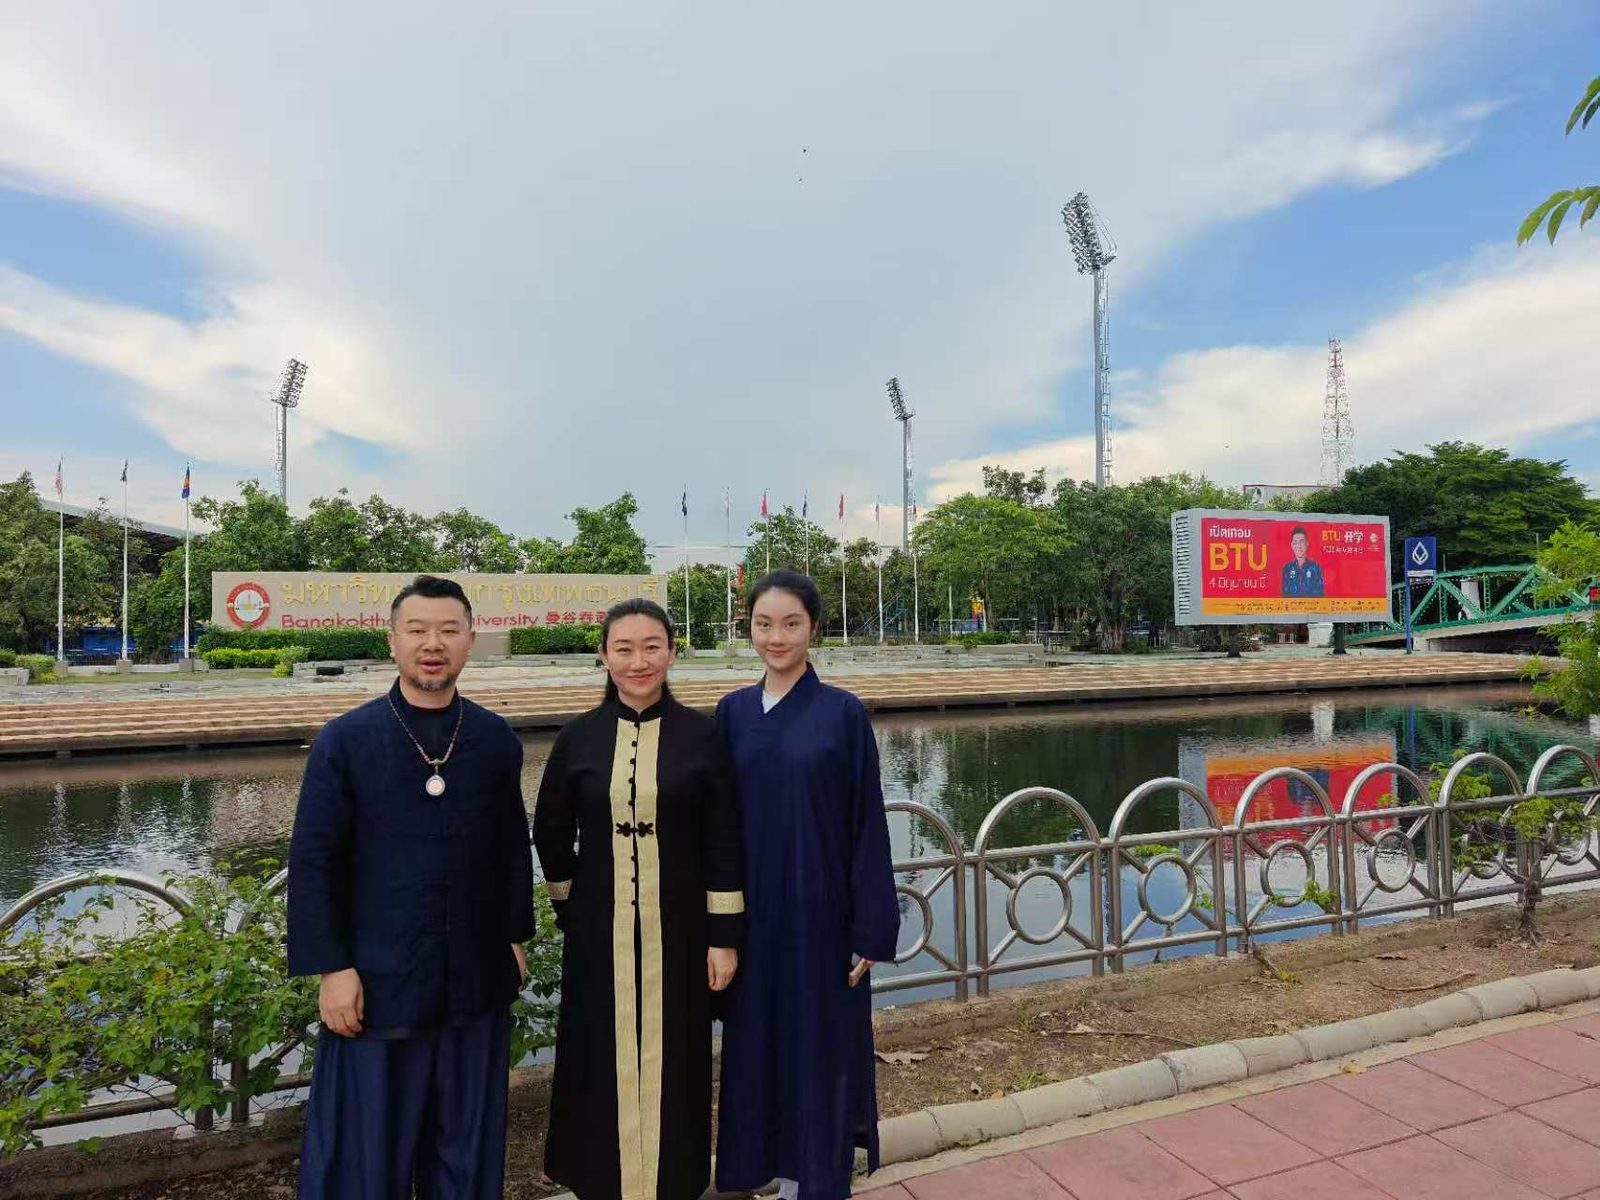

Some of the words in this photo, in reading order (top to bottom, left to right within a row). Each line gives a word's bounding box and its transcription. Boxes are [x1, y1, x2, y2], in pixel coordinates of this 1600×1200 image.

[1322, 530, 1341, 541] BTU
[1209, 543, 1268, 571] BTU
[1208, 577, 1216, 588] 4
[281, 612, 393, 629] Bangkoktho
[471, 613, 539, 627] iversity
